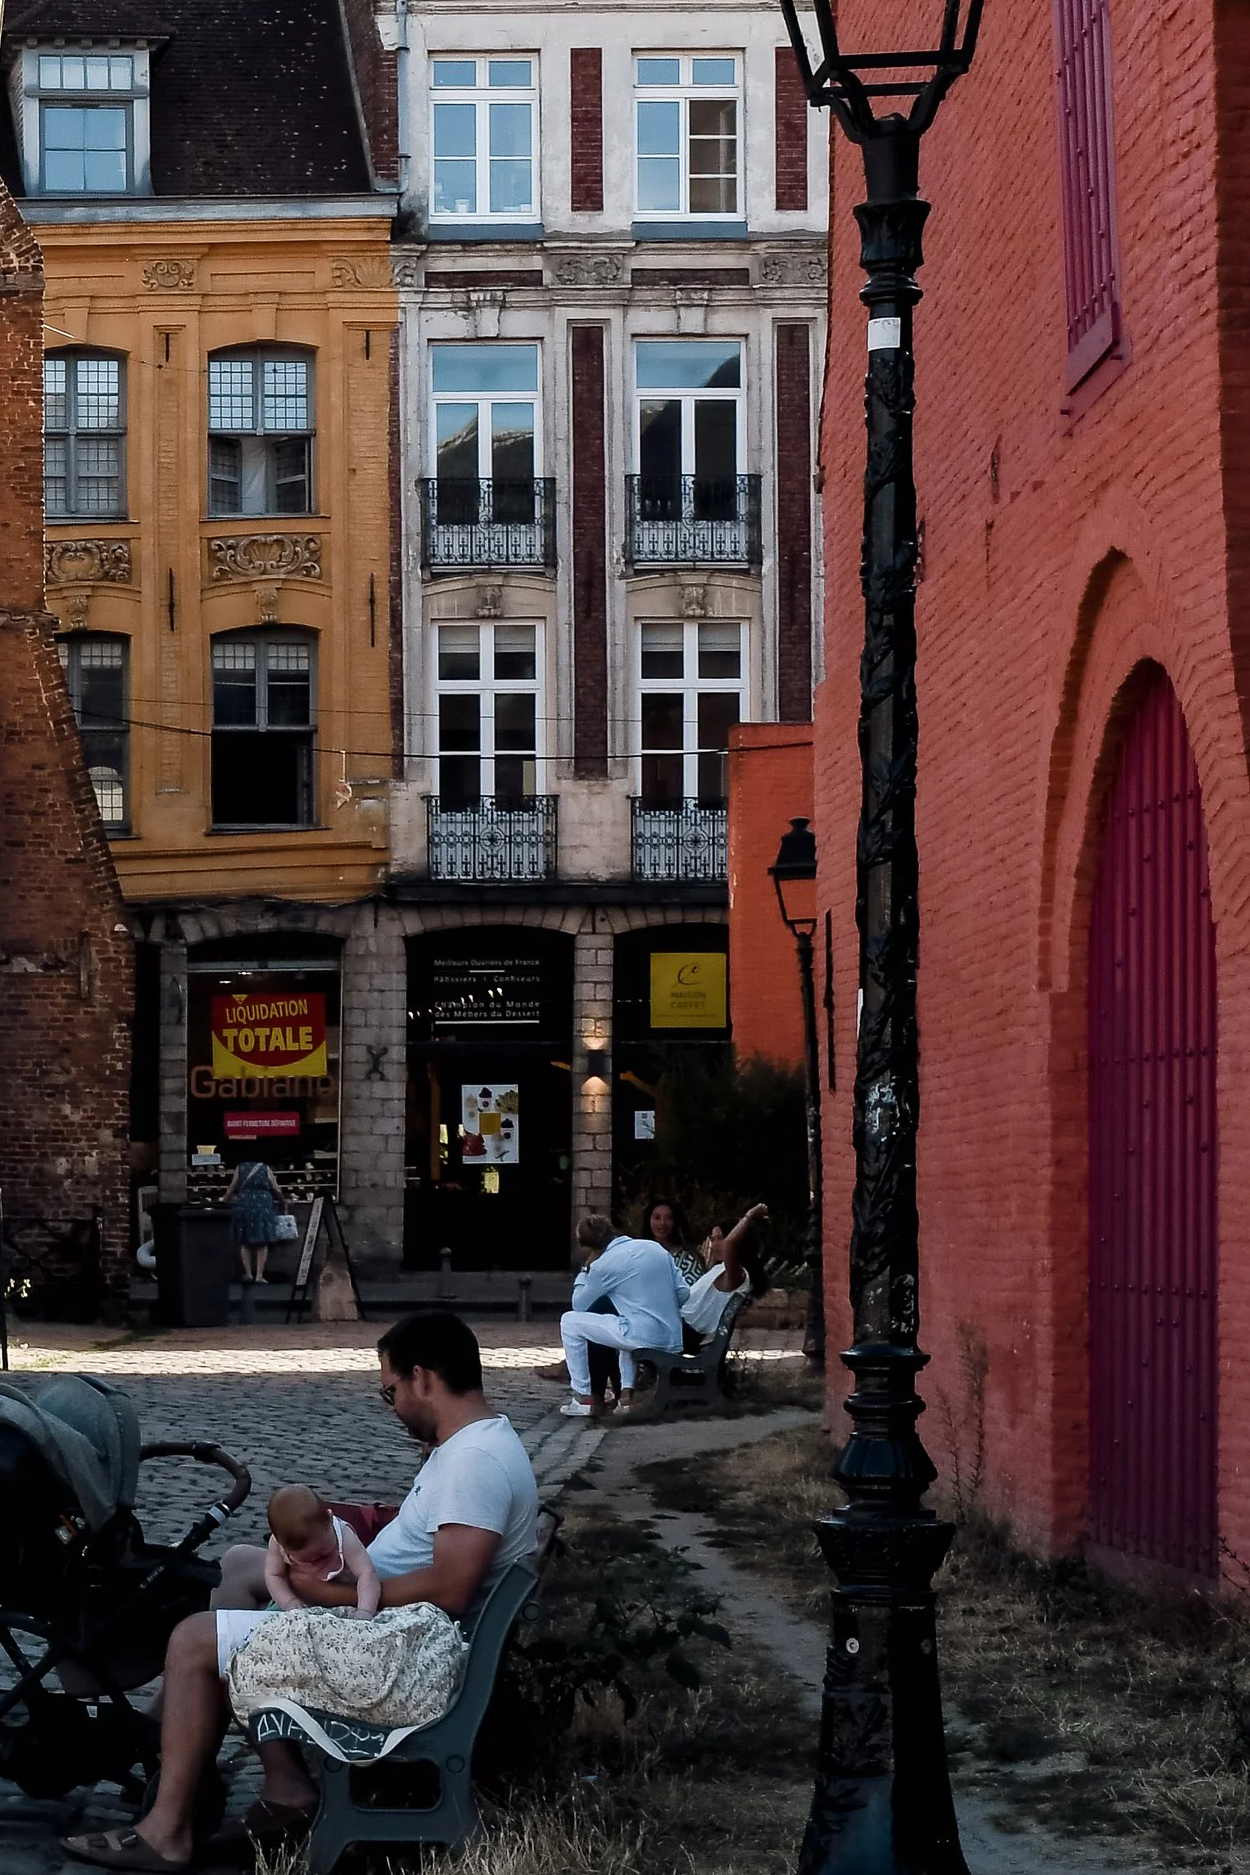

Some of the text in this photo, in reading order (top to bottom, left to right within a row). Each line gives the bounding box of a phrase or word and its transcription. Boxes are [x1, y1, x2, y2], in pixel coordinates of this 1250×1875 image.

[225, 998, 308, 1025] LIQUIDATION
[434, 1010, 450, 1018] des
[222, 1026, 313, 1052] TOTALE
